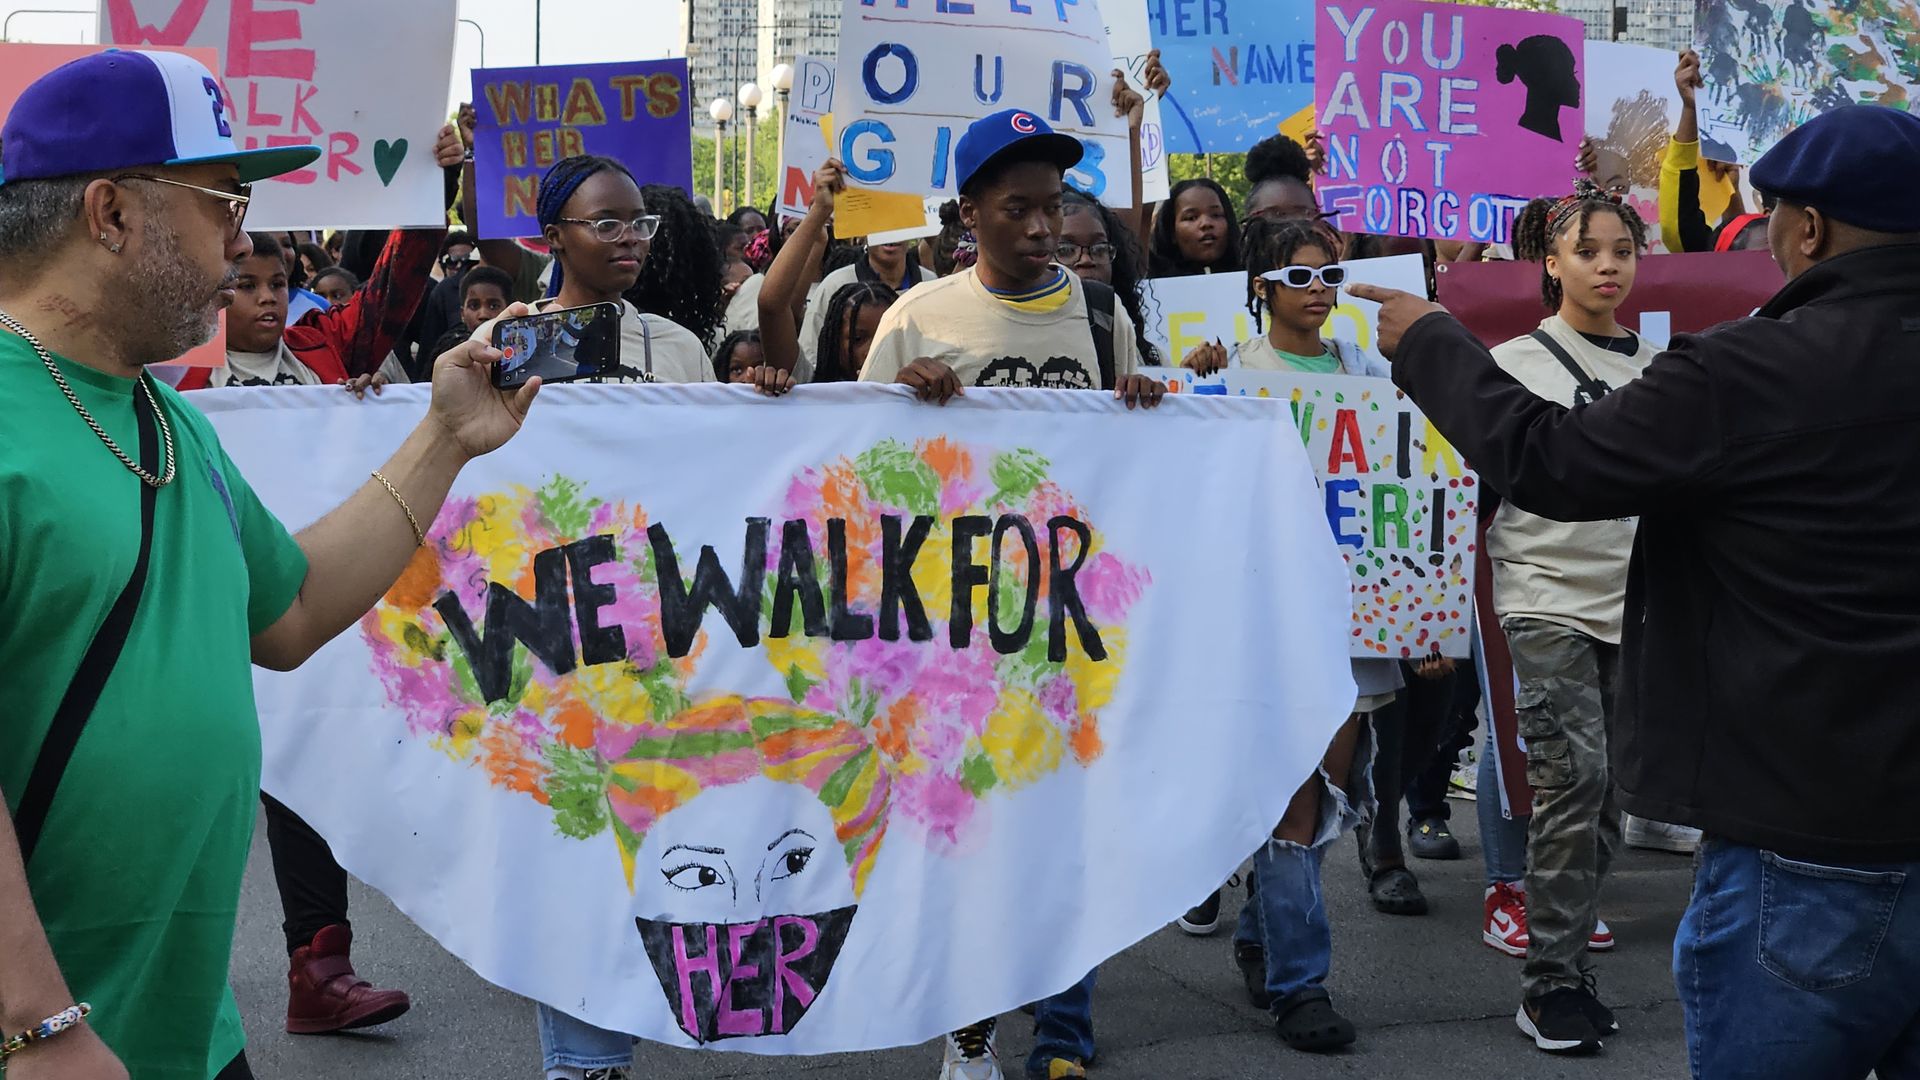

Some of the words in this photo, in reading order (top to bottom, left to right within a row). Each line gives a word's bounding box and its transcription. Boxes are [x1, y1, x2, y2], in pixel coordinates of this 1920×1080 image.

[107, 0, 316, 81] WE
[1211, 43, 1315, 87] NAME
[1325, 6, 1464, 70] YOU
[484, 72, 682, 126] WHATS
[862, 41, 1097, 127] OUR
[1320, 70, 1479, 134] ARE
[1329, 133, 1453, 188] NOT
[432, 533, 628, 706] WE
[646, 514, 935, 659] WALK
[949, 512, 1108, 664] FOR
[671, 914, 819, 1039] HER
